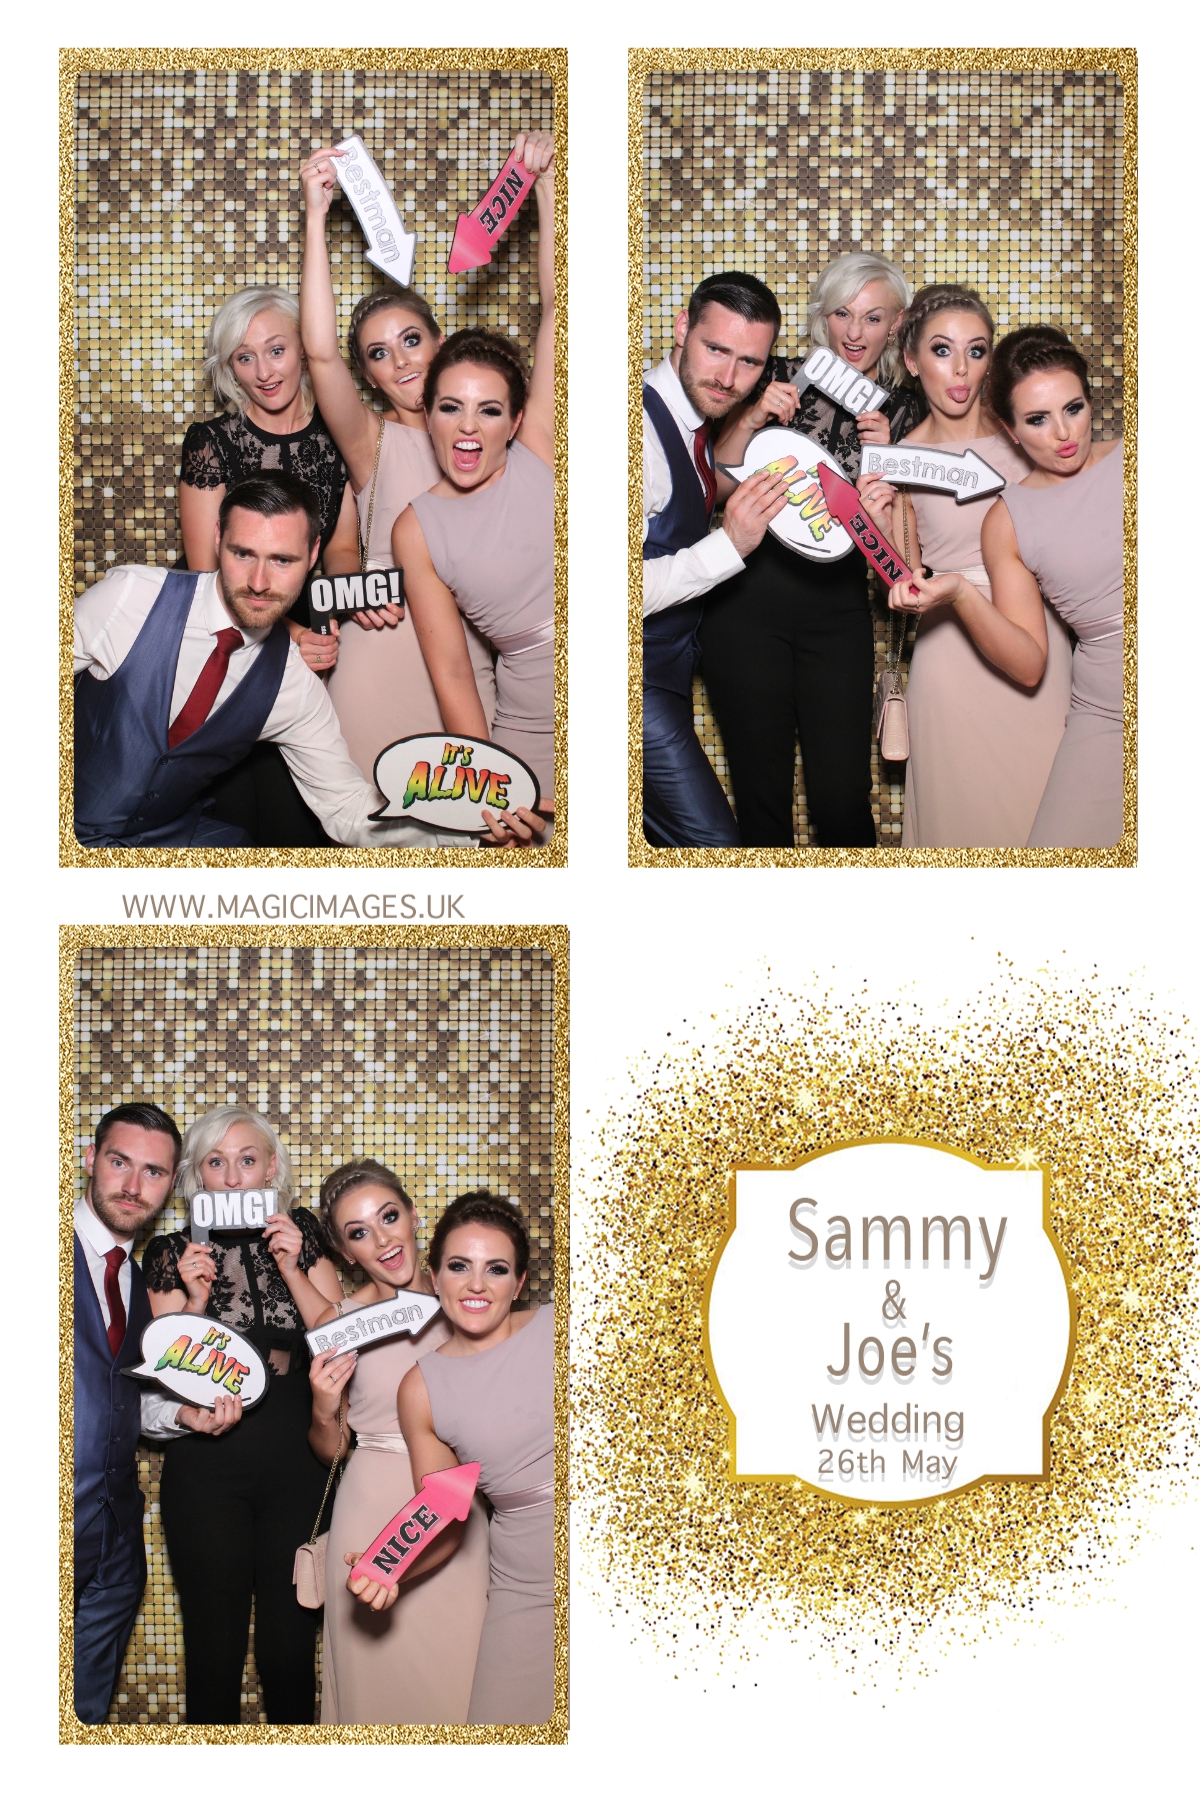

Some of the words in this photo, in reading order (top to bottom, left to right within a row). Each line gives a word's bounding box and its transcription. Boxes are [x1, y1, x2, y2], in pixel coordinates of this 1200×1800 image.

[335, 146, 400, 264] Bestman
[479, 168, 525, 235] NICE
[804, 349, 886, 414] OMG!
[868, 452, 979, 489] Bestman
[849, 514, 904, 583] NICE
[311, 572, 400, 612] OMG!
[441, 742, 474, 765] IT'S
[402, 761, 512, 809] ALIVE
[193, 1191, 275, 1228] OMG!
[201, 1326, 231, 1351] IT'S
[315, 1303, 424, 1354] Bestman
[154, 1335, 251, 1395] ALIVE
[370, 1503, 441, 1576] NICE
